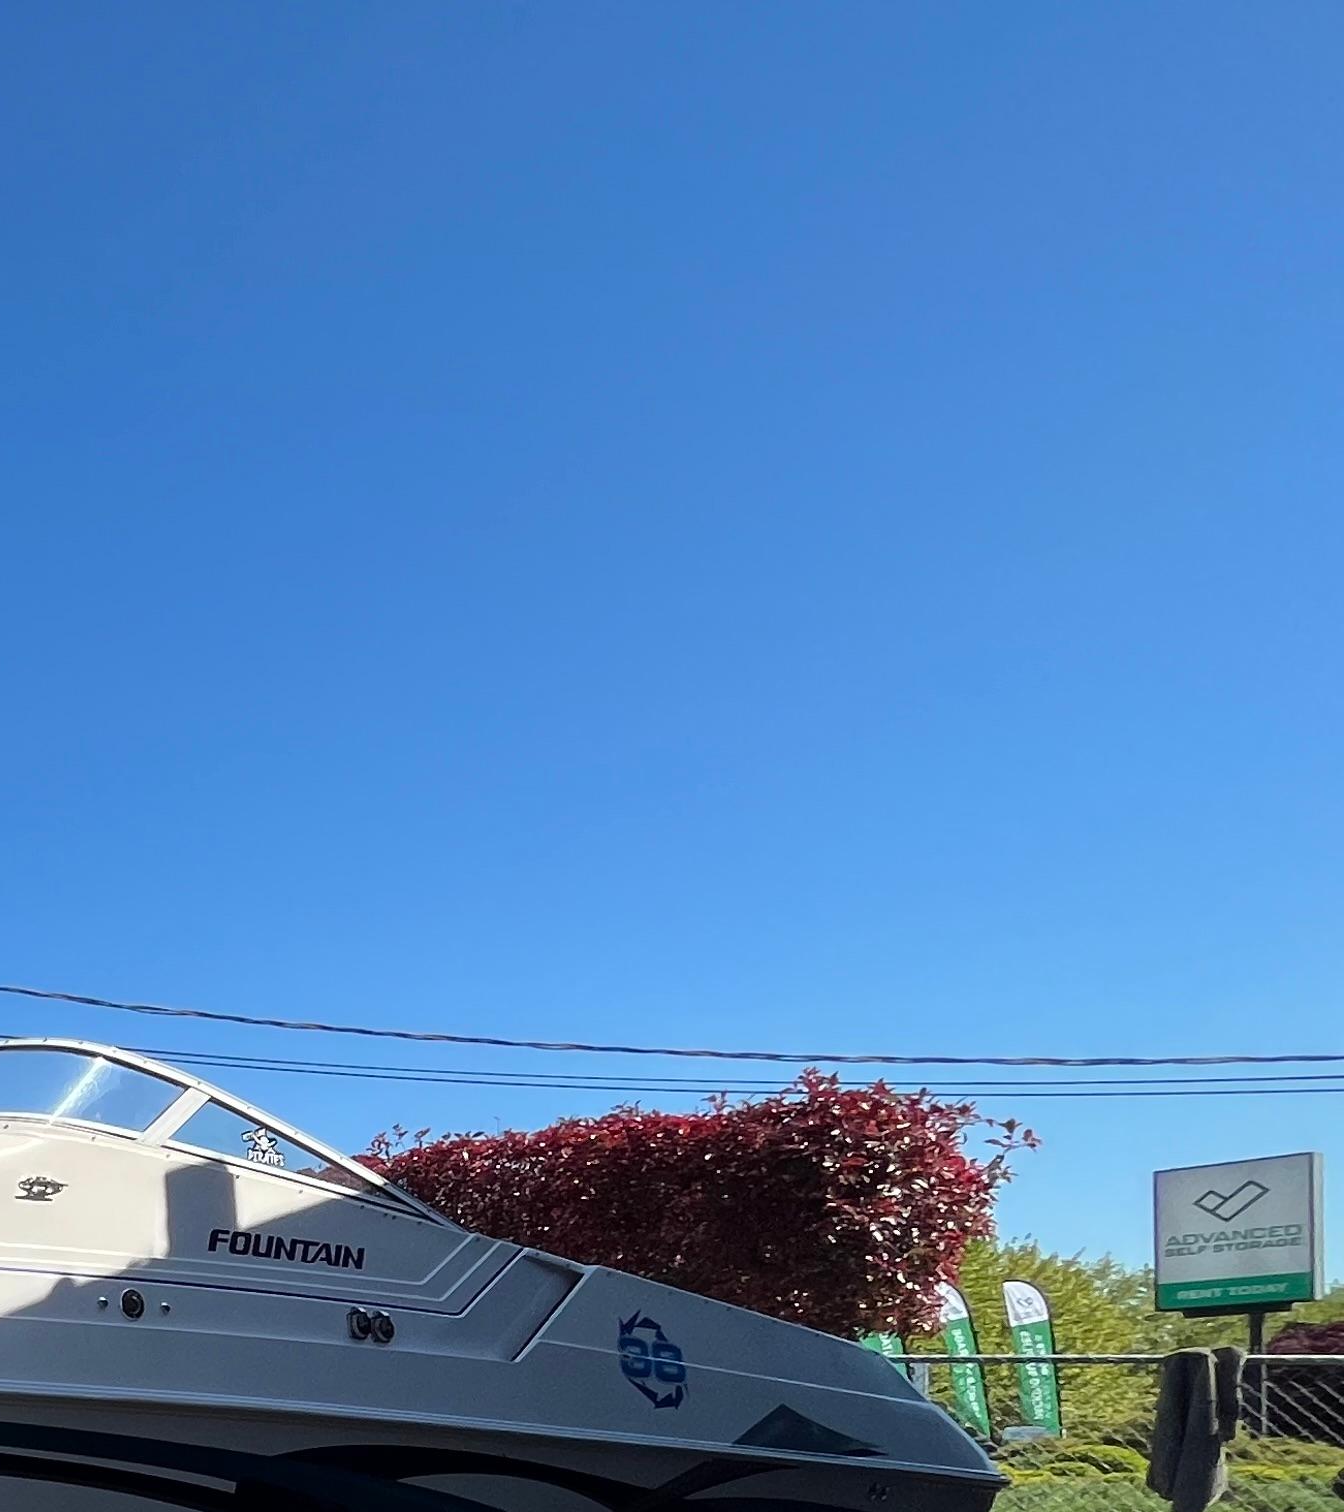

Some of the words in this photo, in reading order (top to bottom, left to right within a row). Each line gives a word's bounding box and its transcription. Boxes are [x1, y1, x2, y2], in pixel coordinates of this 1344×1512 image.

[1165, 1224, 1303, 1247] ADVANCED
[208, 1229, 365, 1270] FOUNTAIN
[1165, 1245, 1211, 1258] SELF
[1213, 1237, 1302, 1253] STORAGE
